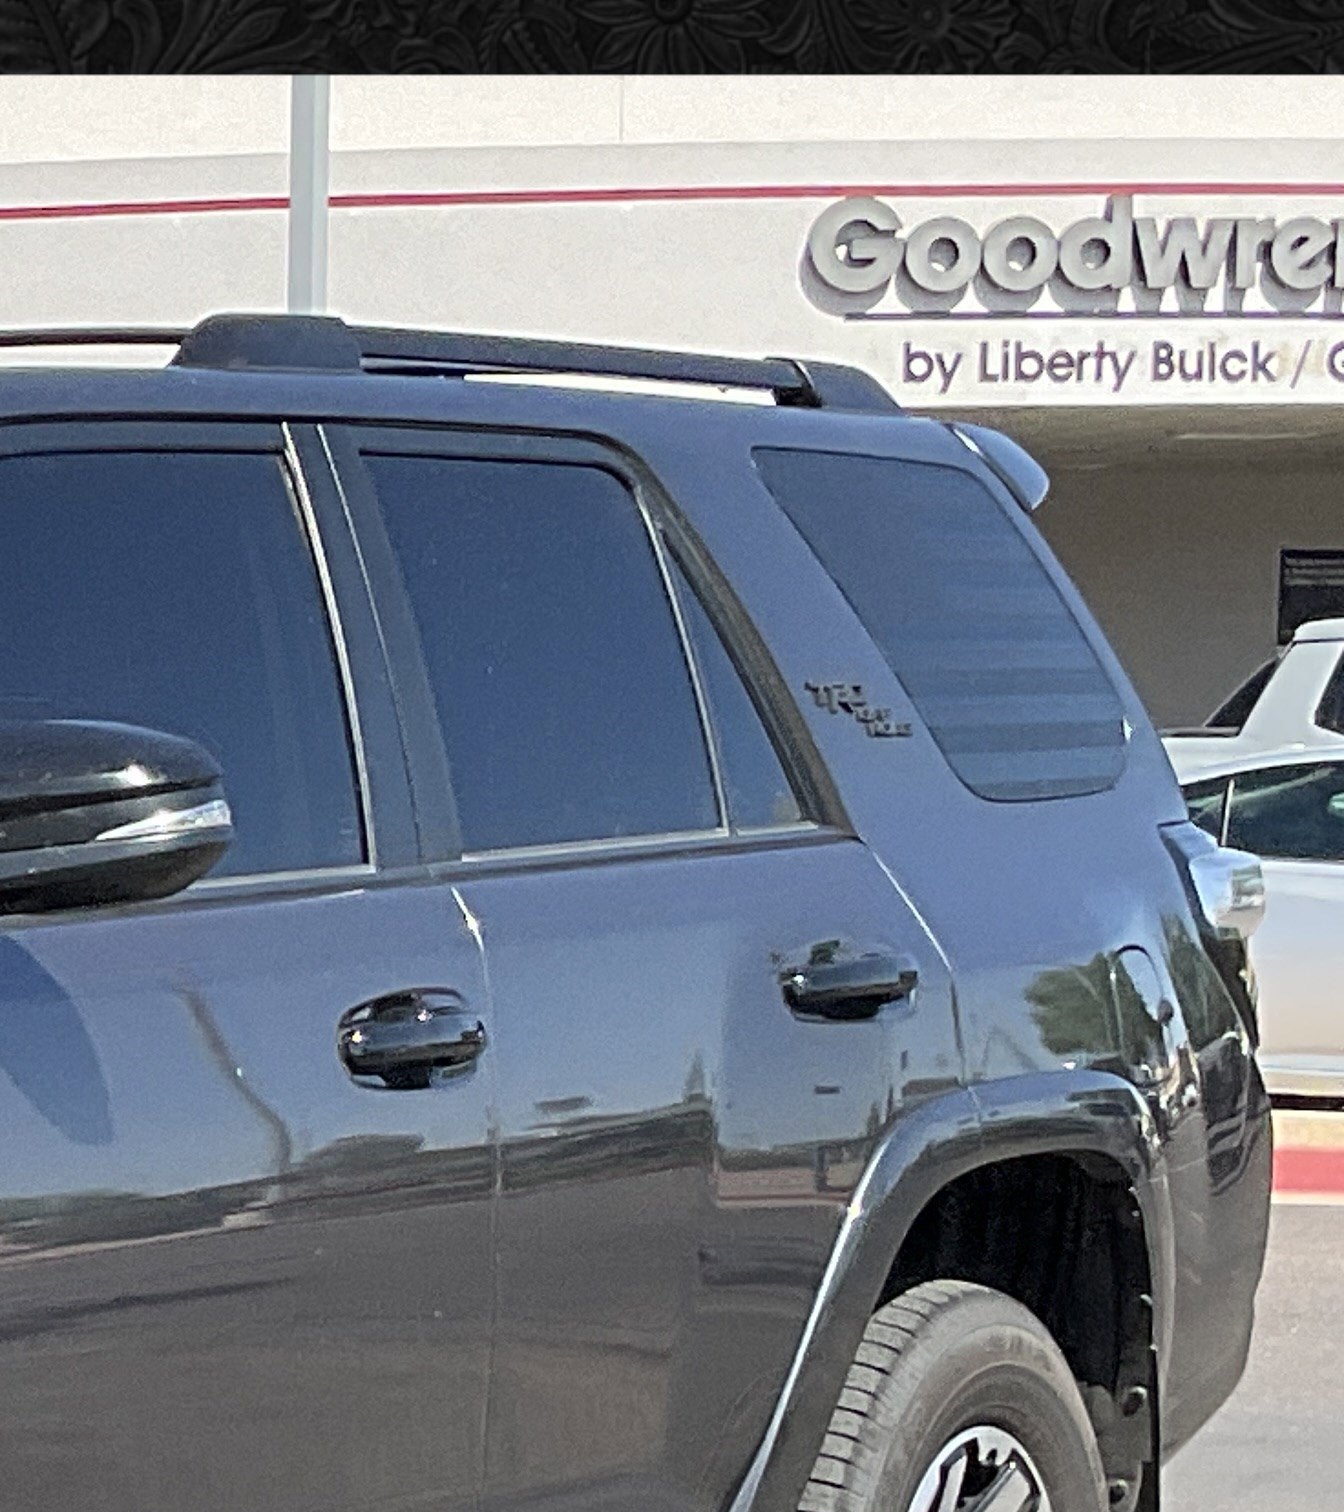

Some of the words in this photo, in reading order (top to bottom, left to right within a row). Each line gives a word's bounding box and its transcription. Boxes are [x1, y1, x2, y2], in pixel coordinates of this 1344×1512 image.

[809, 195, 1344, 293] Goodwre
[902, 341, 964, 393] by
[978, 340, 1137, 393] Liberty
[1150, 340, 1278, 383] Buick
